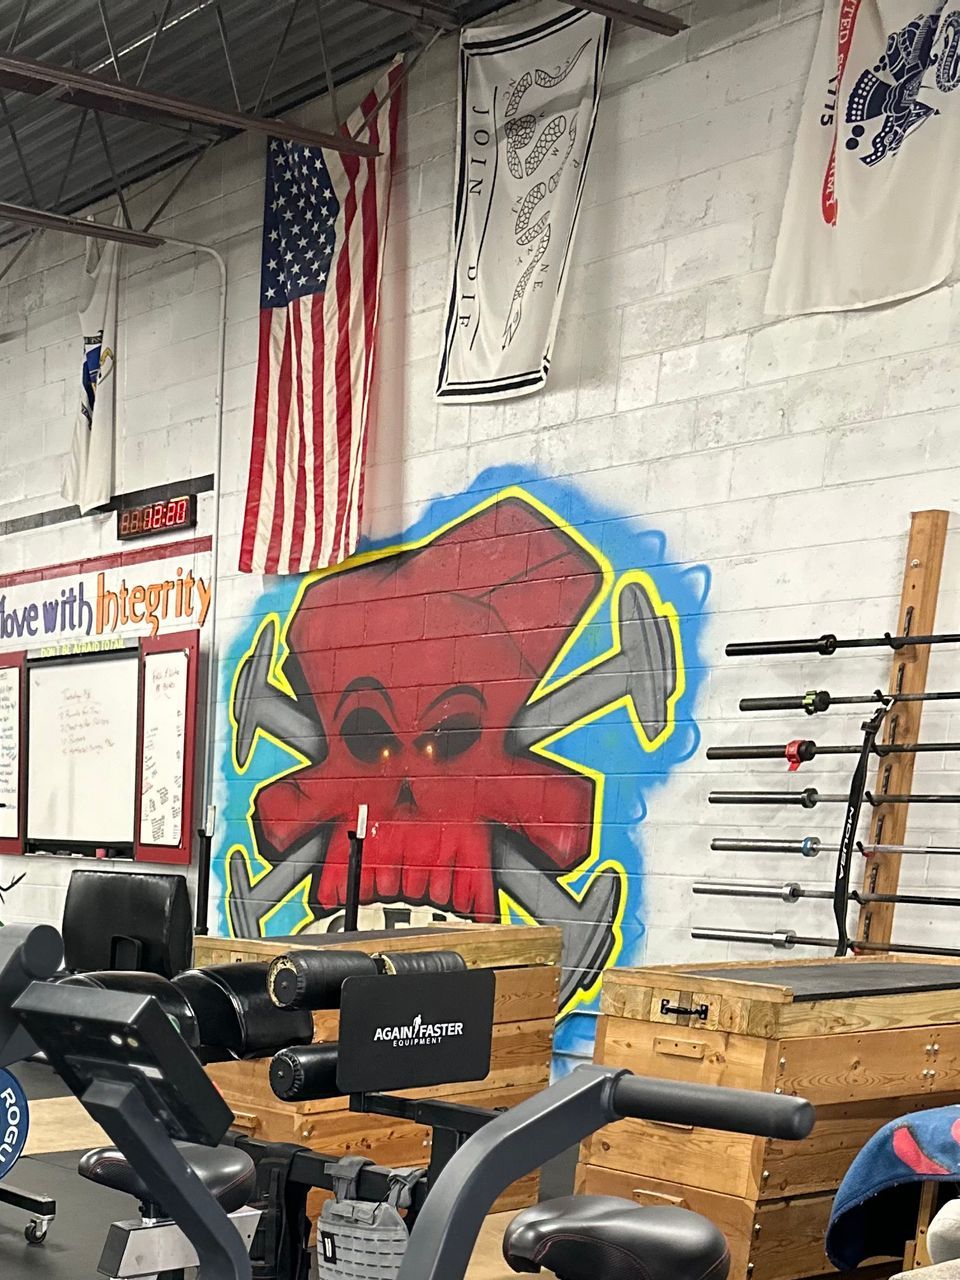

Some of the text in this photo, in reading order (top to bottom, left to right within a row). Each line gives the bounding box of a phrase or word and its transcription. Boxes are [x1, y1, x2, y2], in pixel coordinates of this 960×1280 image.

[469, 105, 490, 197] JOIN
[42, 581, 94, 636] with
[95, 566, 212, 638] Integrity
[373, 1022, 464, 1041] AGAIN FASTER
[393, 1036, 442, 1047] EQUIPMENT
